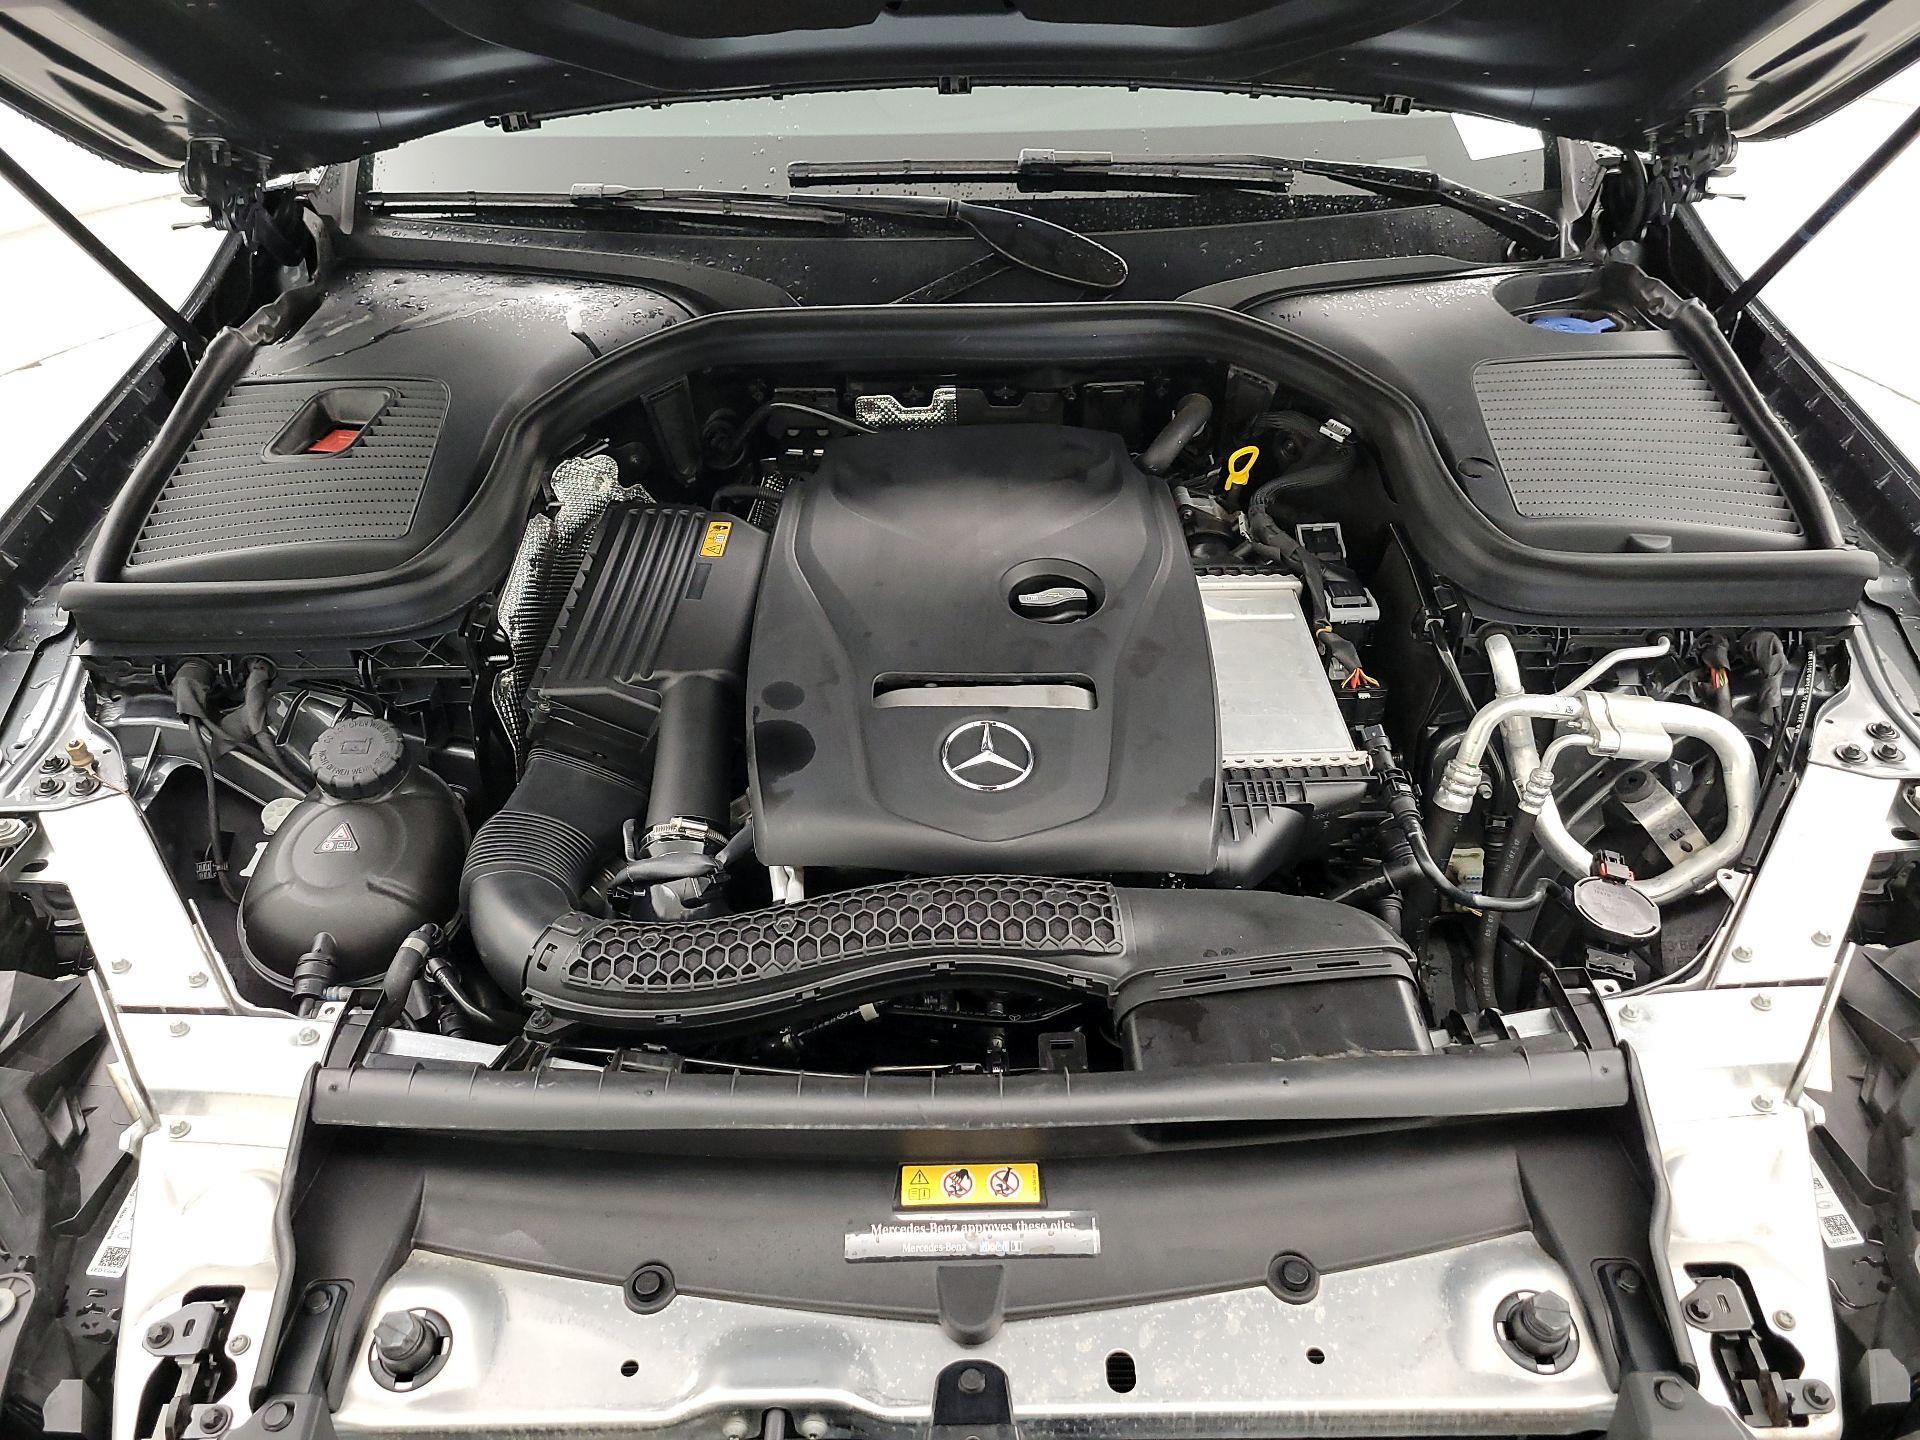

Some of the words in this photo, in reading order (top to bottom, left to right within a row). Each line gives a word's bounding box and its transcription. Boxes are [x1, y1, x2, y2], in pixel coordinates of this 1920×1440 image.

[870, 1222, 958, 1236] Mercedes-Benz
[960, 1221, 1014, 1234] approves
[1015, 1219, 1048, 1231] these
